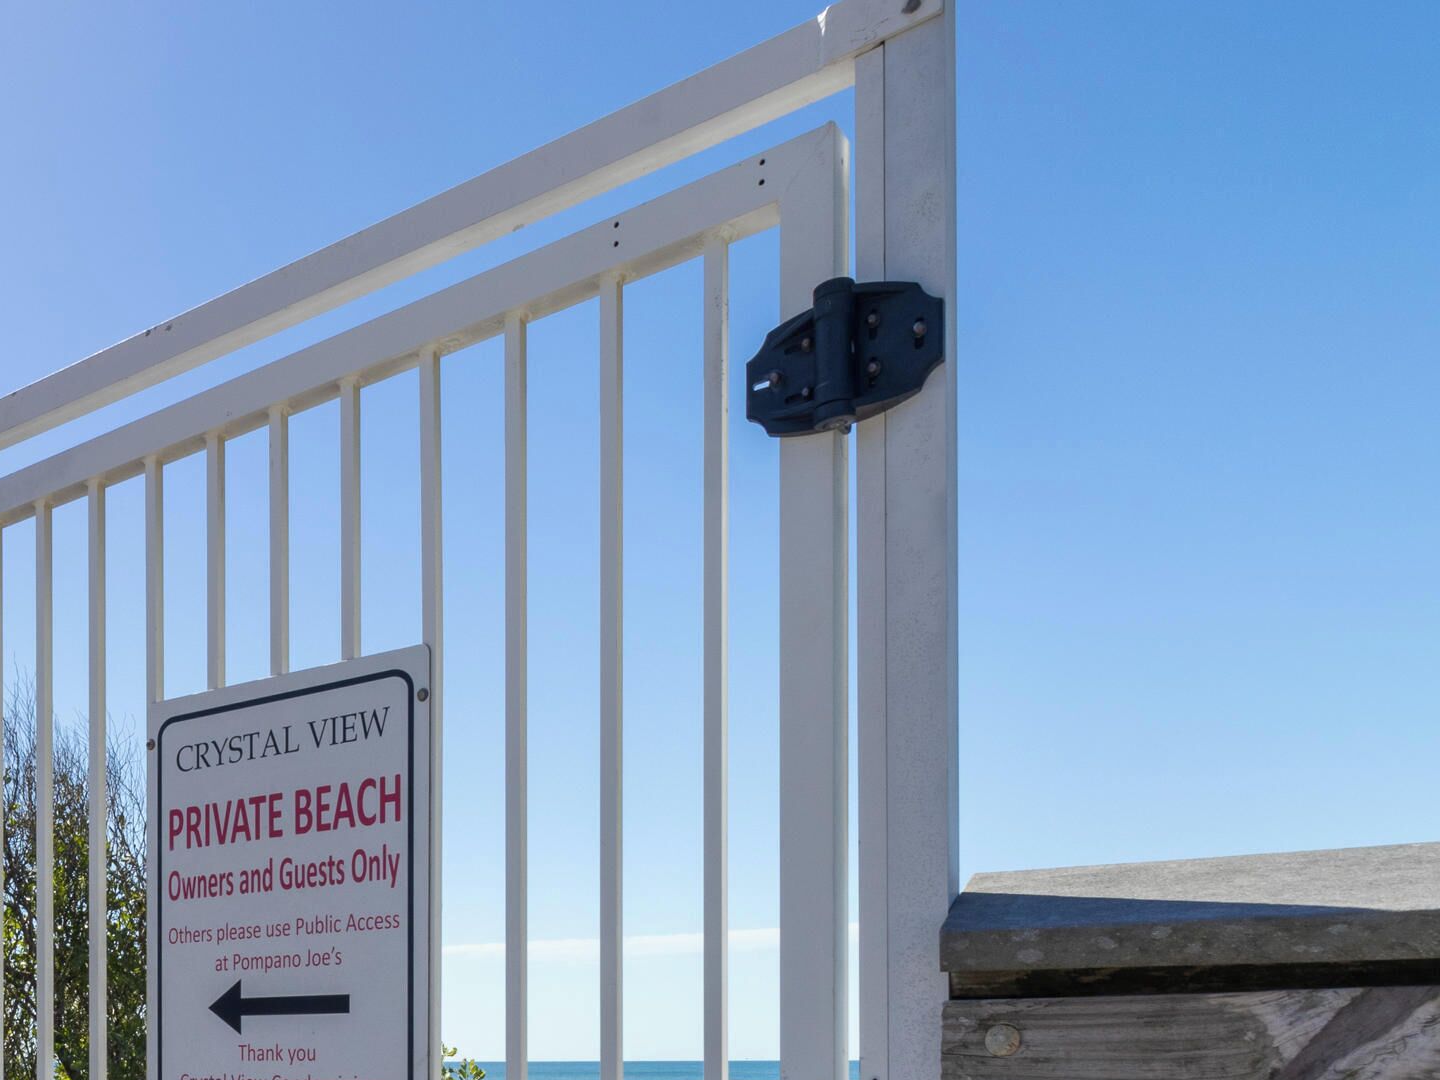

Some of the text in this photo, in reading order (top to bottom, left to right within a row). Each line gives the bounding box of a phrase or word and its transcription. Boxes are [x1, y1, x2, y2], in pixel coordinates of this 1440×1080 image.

[176, 706, 390, 772] CRYSTAL VIEW
[168, 773, 402, 851] PRIVATE BEACH
[168, 843, 401, 902] Owners and Guests Only
[168, 913, 401, 945] Others please use Public Access
[215, 946, 343, 974] at Pompano Joe's
[238, 1043, 316, 1066] Thank you
